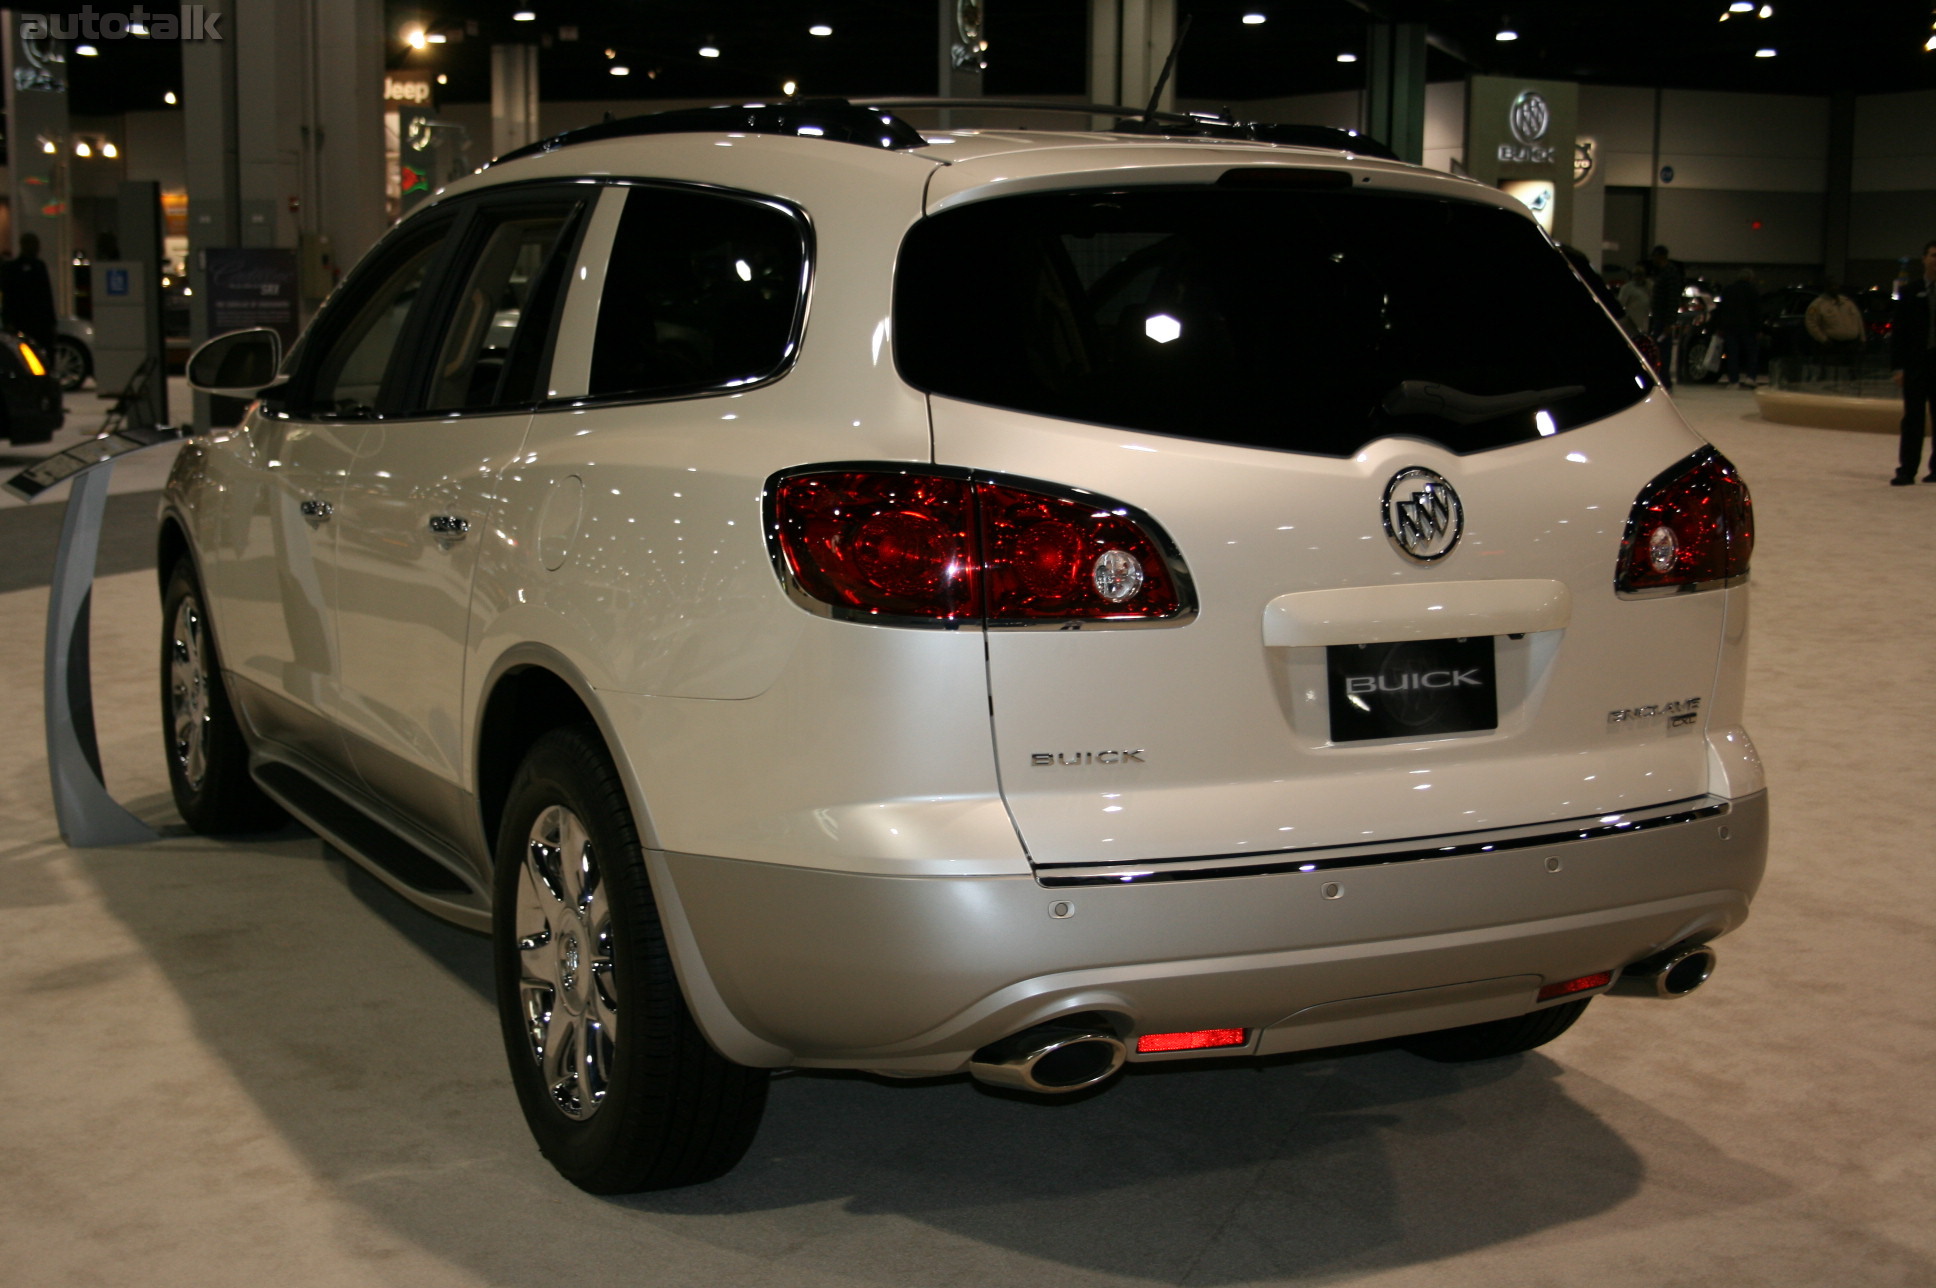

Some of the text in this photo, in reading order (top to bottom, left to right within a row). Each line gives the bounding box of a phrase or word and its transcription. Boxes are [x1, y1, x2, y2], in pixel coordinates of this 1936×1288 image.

[384, 77, 430, 103] Jeep
[1498, 145, 1555, 163] BUICK
[1345, 668, 1483, 694] BUICK
[1608, 697, 1701, 722] ENCLAVE
[1031, 749, 1145, 767] BUICK
